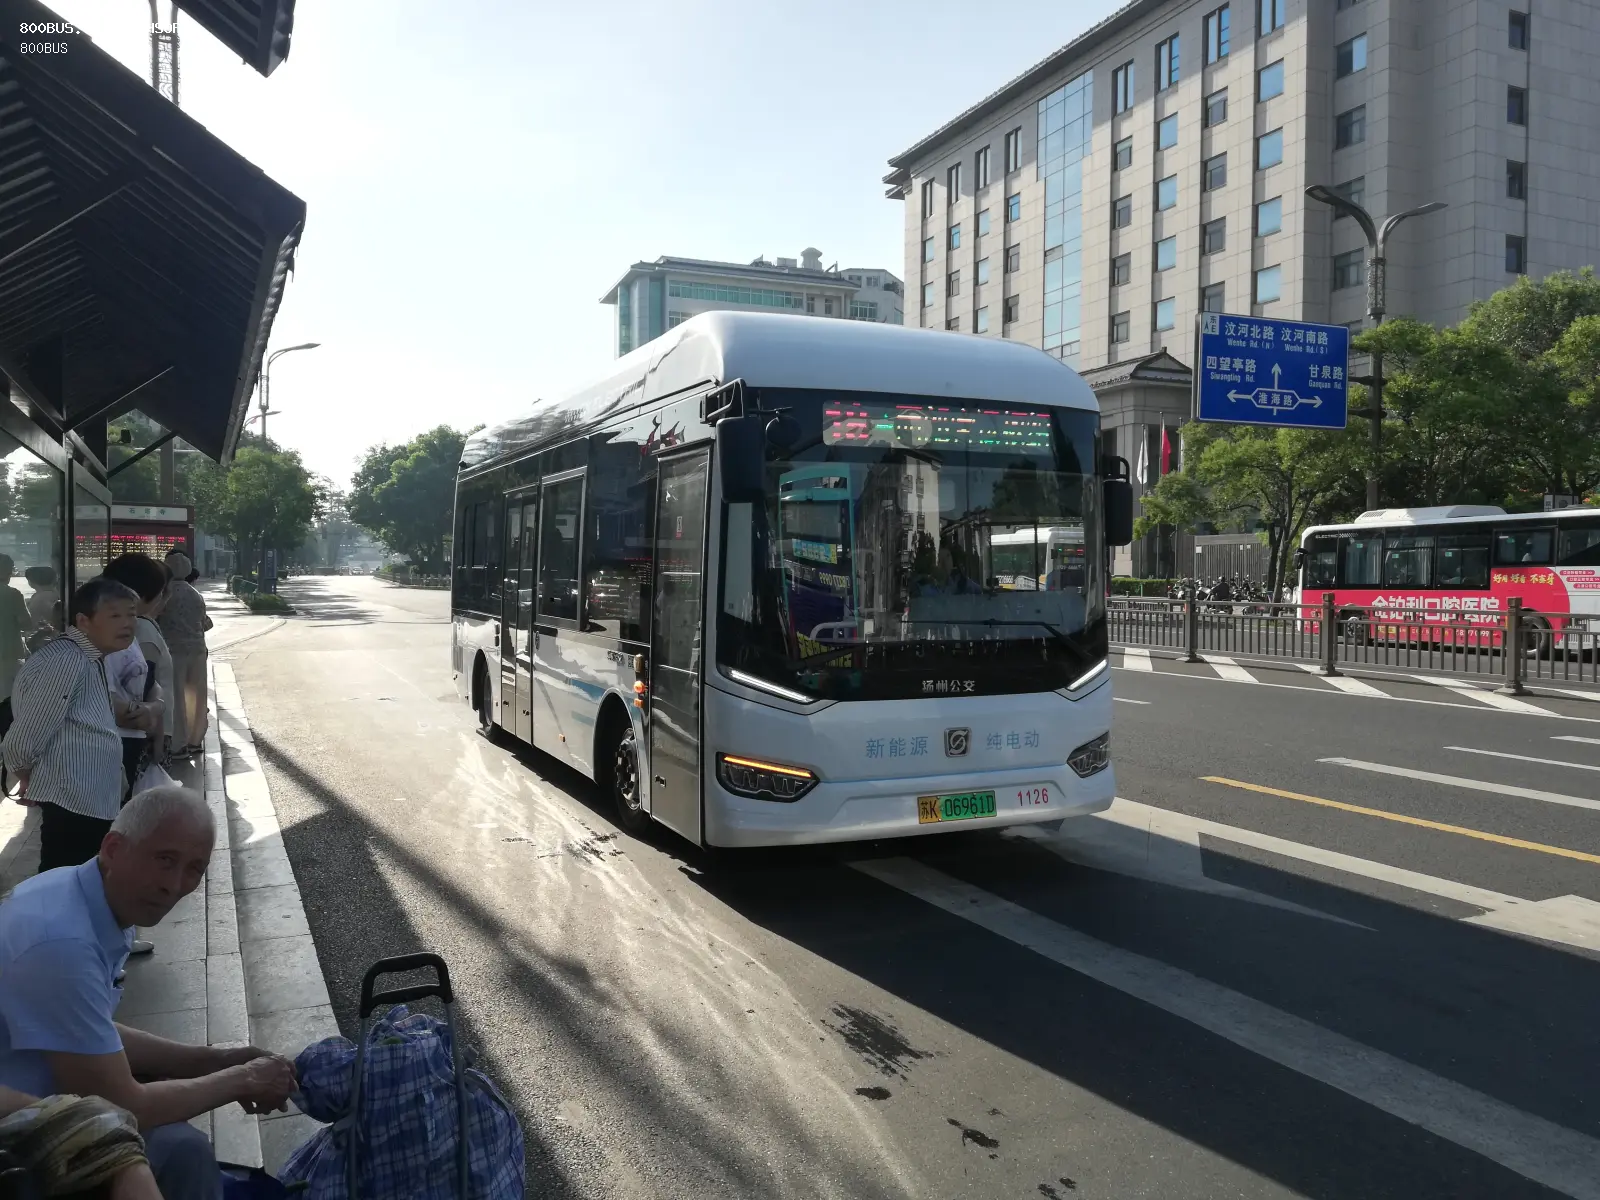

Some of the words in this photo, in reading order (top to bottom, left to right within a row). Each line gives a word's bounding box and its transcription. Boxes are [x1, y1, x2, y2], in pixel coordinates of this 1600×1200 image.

[1211, 325, 1216, 333] E
[1225, 321, 1274, 340] 汶河北路
[1281, 327, 1328, 345] 汶河南路
[1206, 355, 1256, 373] 四望亭路
[1309, 364, 1343, 380] 甘泉路
[1258, 392, 1292, 406] 淮海路
[921, 679, 976, 693] 扬州公交
[865, 736, 929, 759] 新能源
[986, 729, 1040, 751] 纯电动
[1017, 787, 1049, 807] 1126
